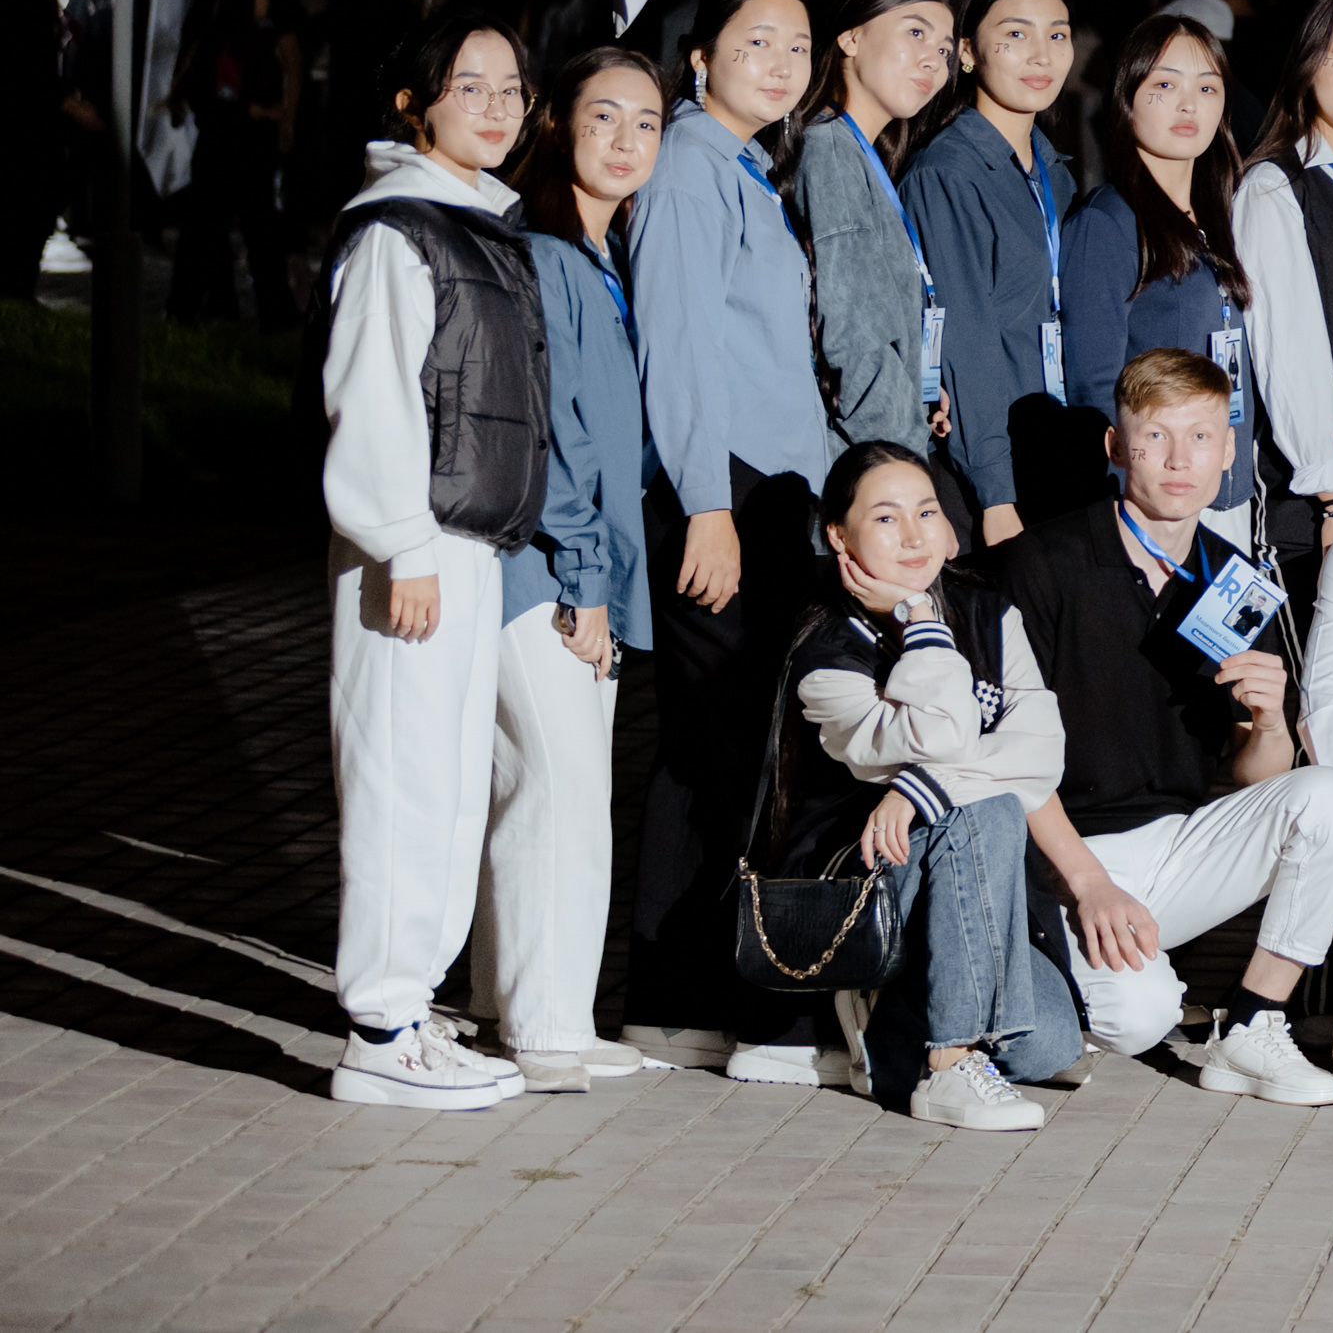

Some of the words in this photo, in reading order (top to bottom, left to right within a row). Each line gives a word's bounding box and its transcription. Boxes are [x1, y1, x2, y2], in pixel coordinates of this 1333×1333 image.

[994, 42, 1011, 54] JR
[732, 49, 750, 64] JR
[1147, 93, 1164, 106] JR
[581, 125, 598, 138] JR
[1044, 330, 1057, 365] JR
[1131, 448, 1147, 461] JR
[1213, 562, 1242, 605] JR
